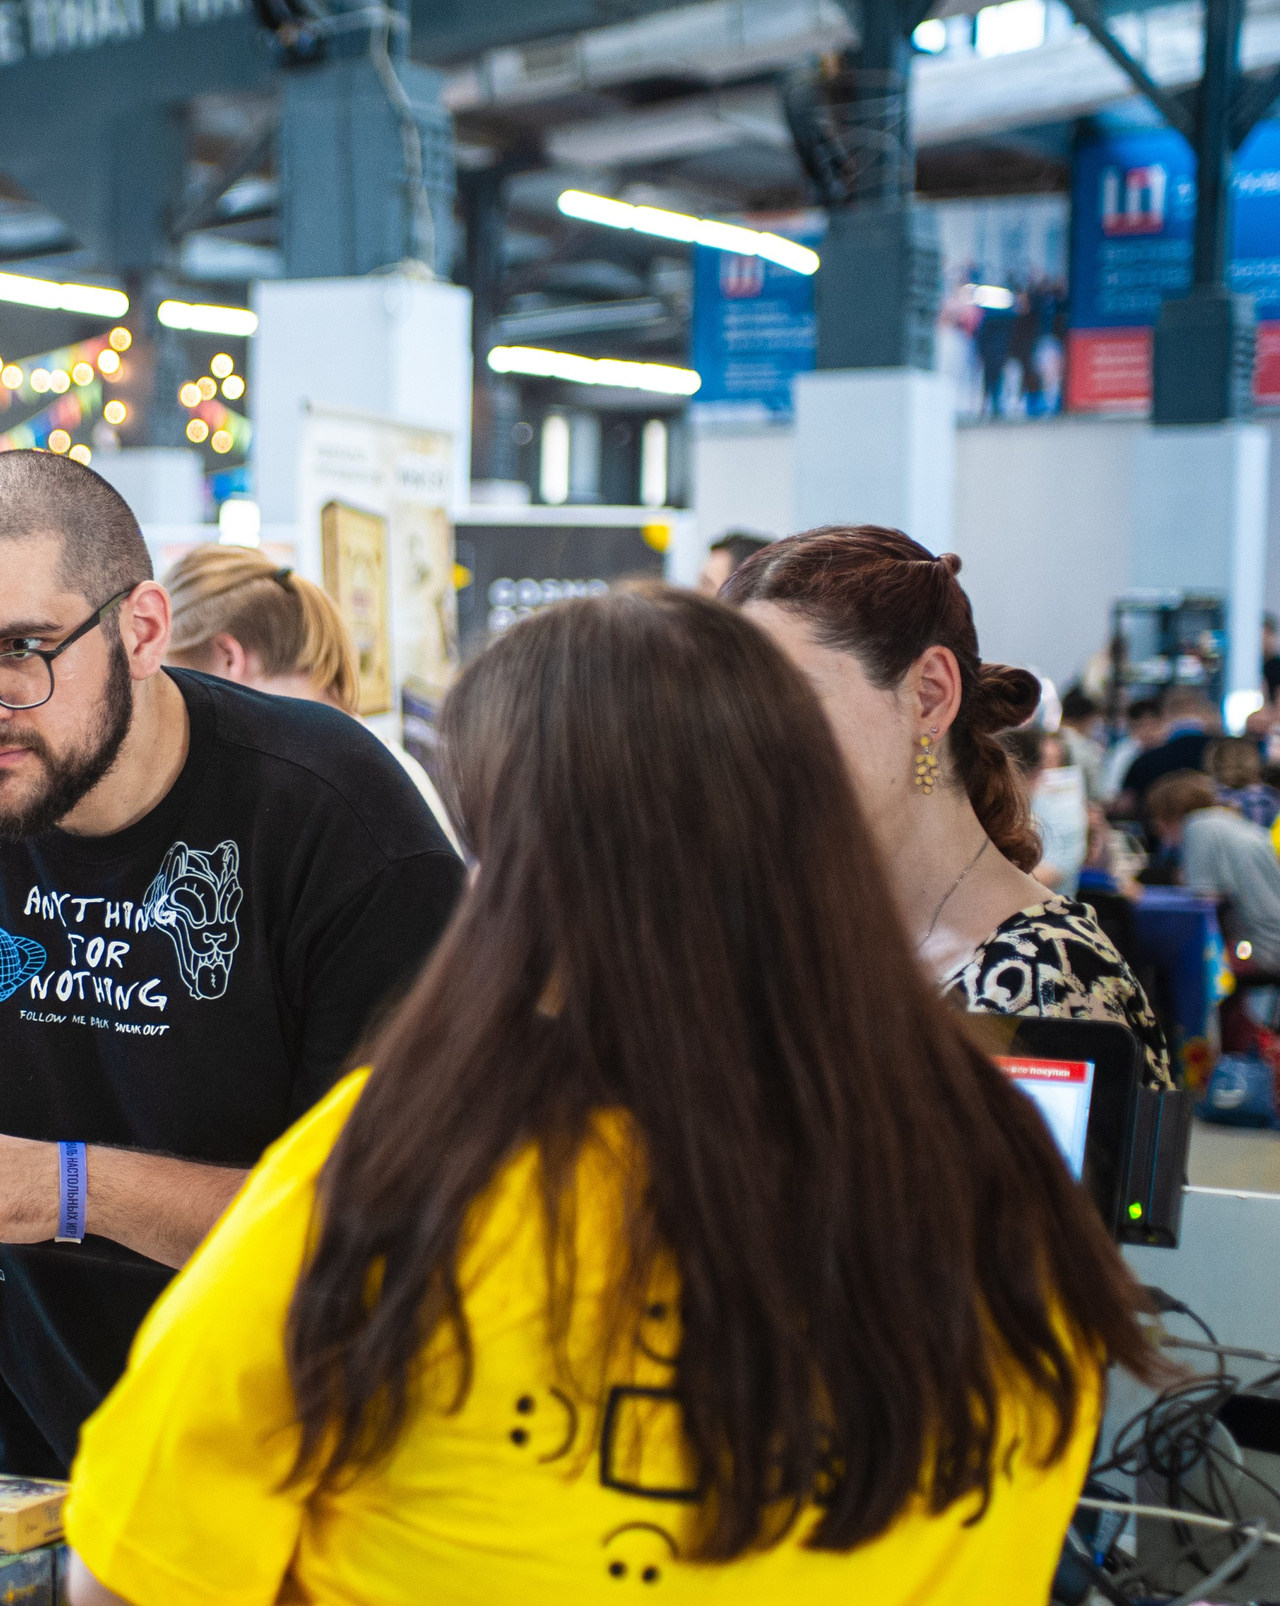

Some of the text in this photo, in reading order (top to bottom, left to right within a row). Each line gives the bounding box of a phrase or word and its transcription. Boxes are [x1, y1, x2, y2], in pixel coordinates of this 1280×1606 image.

[23, 886, 177, 933] ANYTHING
[68, 933, 130, 968] FOR
[30, 970, 168, 1012] NOTHING
[20, 1009, 67, 1024] FOLLOW
[72, 1015, 86, 1025] ME
[90, 1016, 109, 1029] BACK
[142, 1024, 170, 1037] OUT
[66, 1157, 79, 1220] НАСТОЛЬНЫХ
